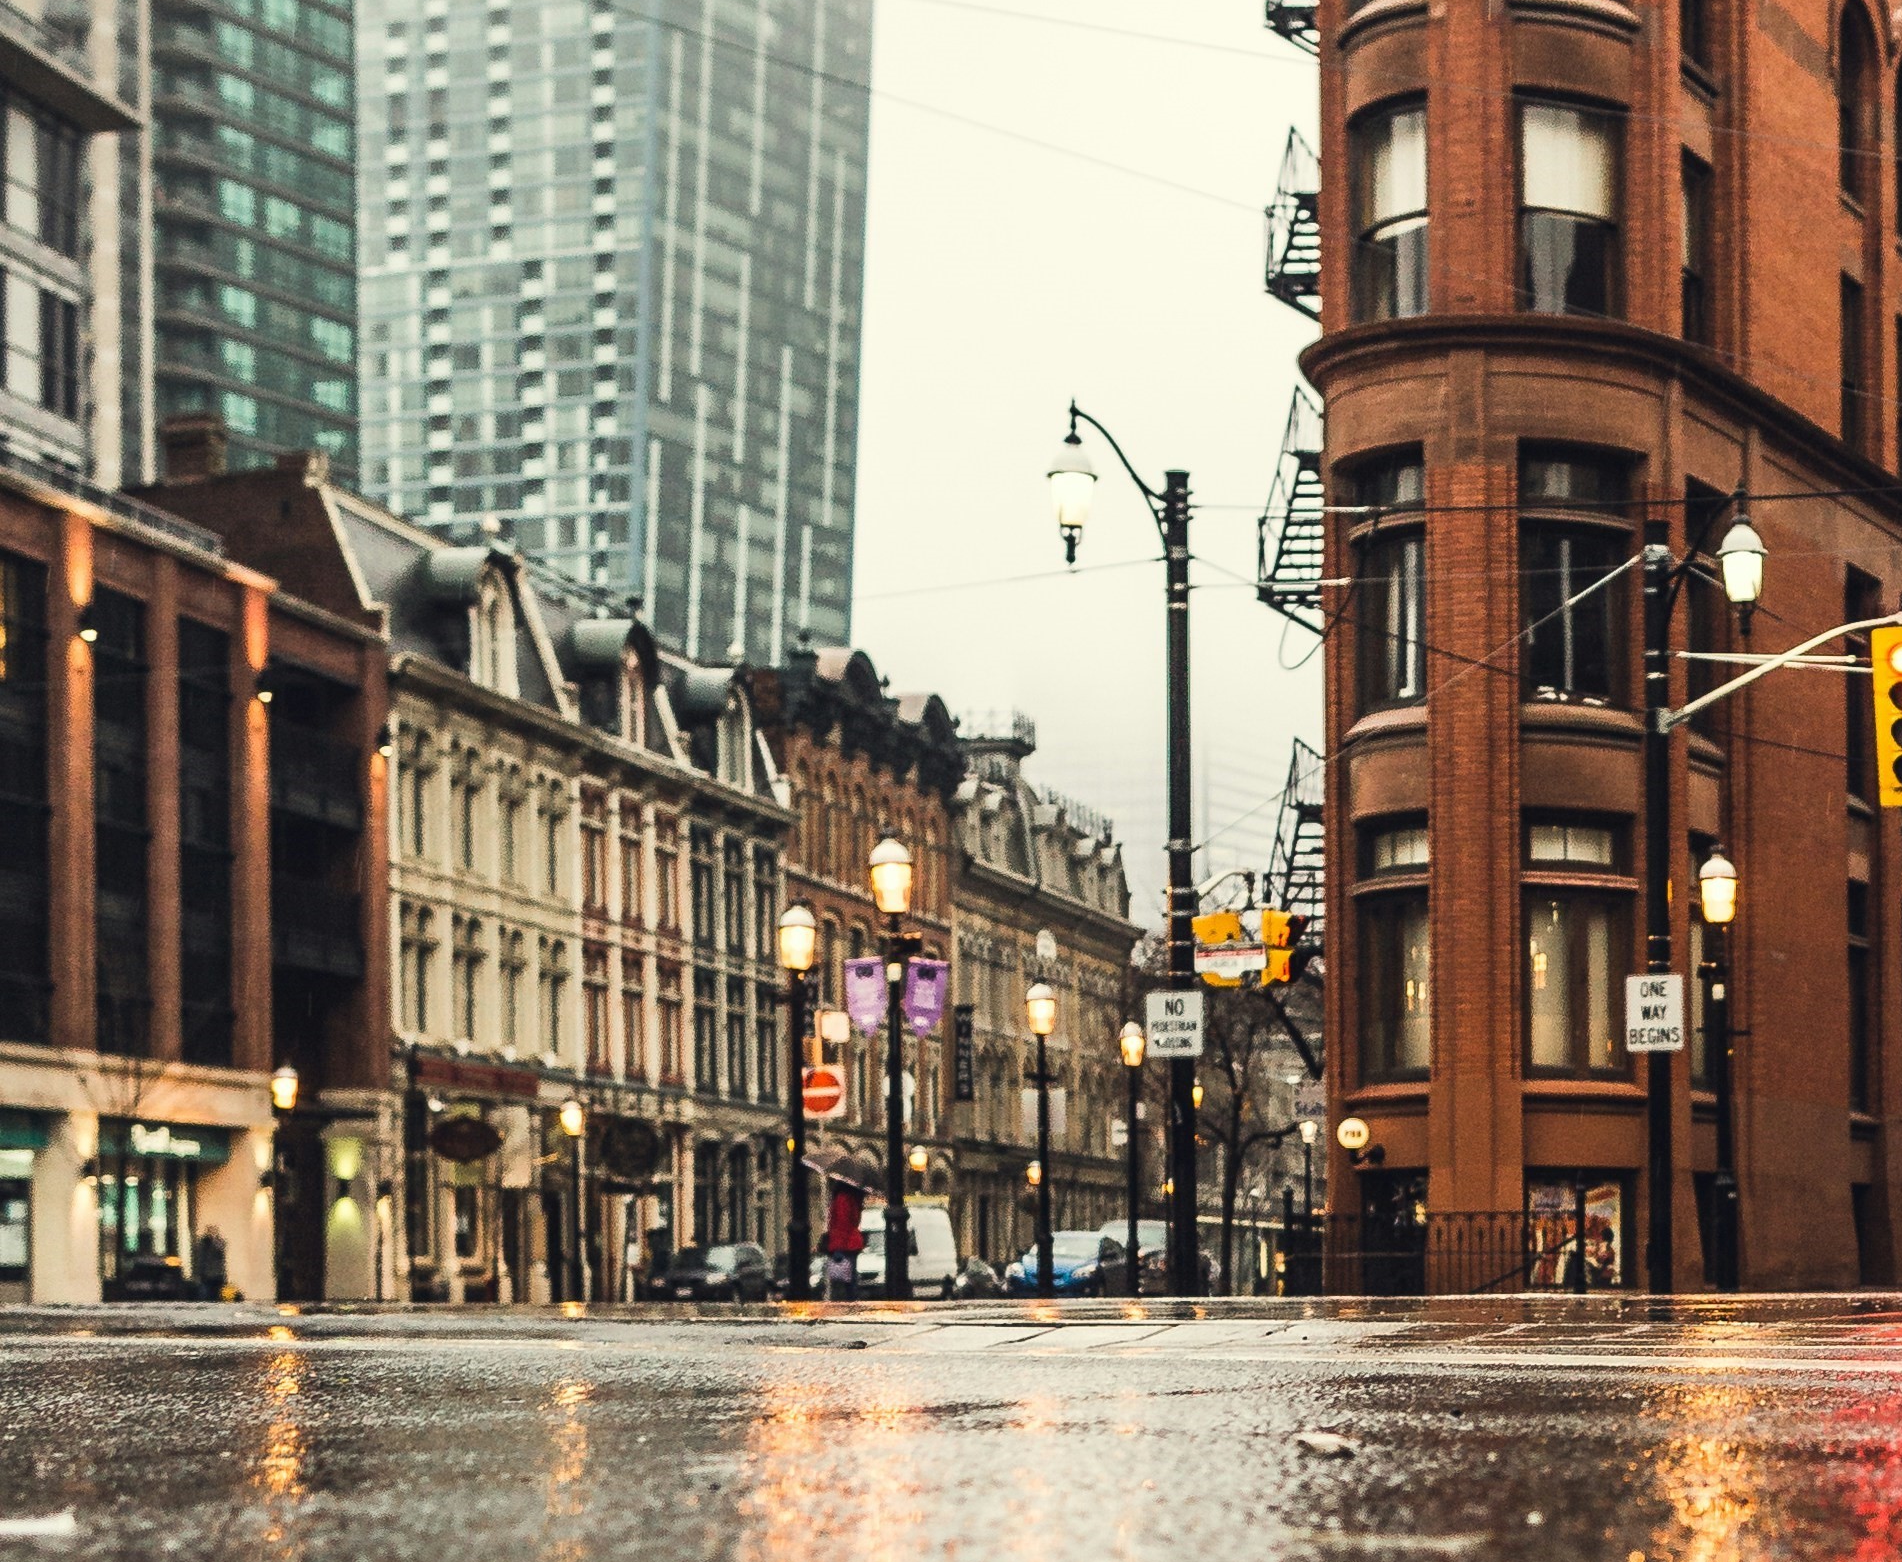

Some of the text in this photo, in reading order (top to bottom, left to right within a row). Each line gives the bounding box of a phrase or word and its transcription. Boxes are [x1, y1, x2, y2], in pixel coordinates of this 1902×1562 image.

[1639, 980, 1668, 998] ONE
[1164, 997, 1185, 1017] NO
[1640, 1003, 1667, 1021] WAY
[1628, 1026, 1681, 1045] BEGINS
